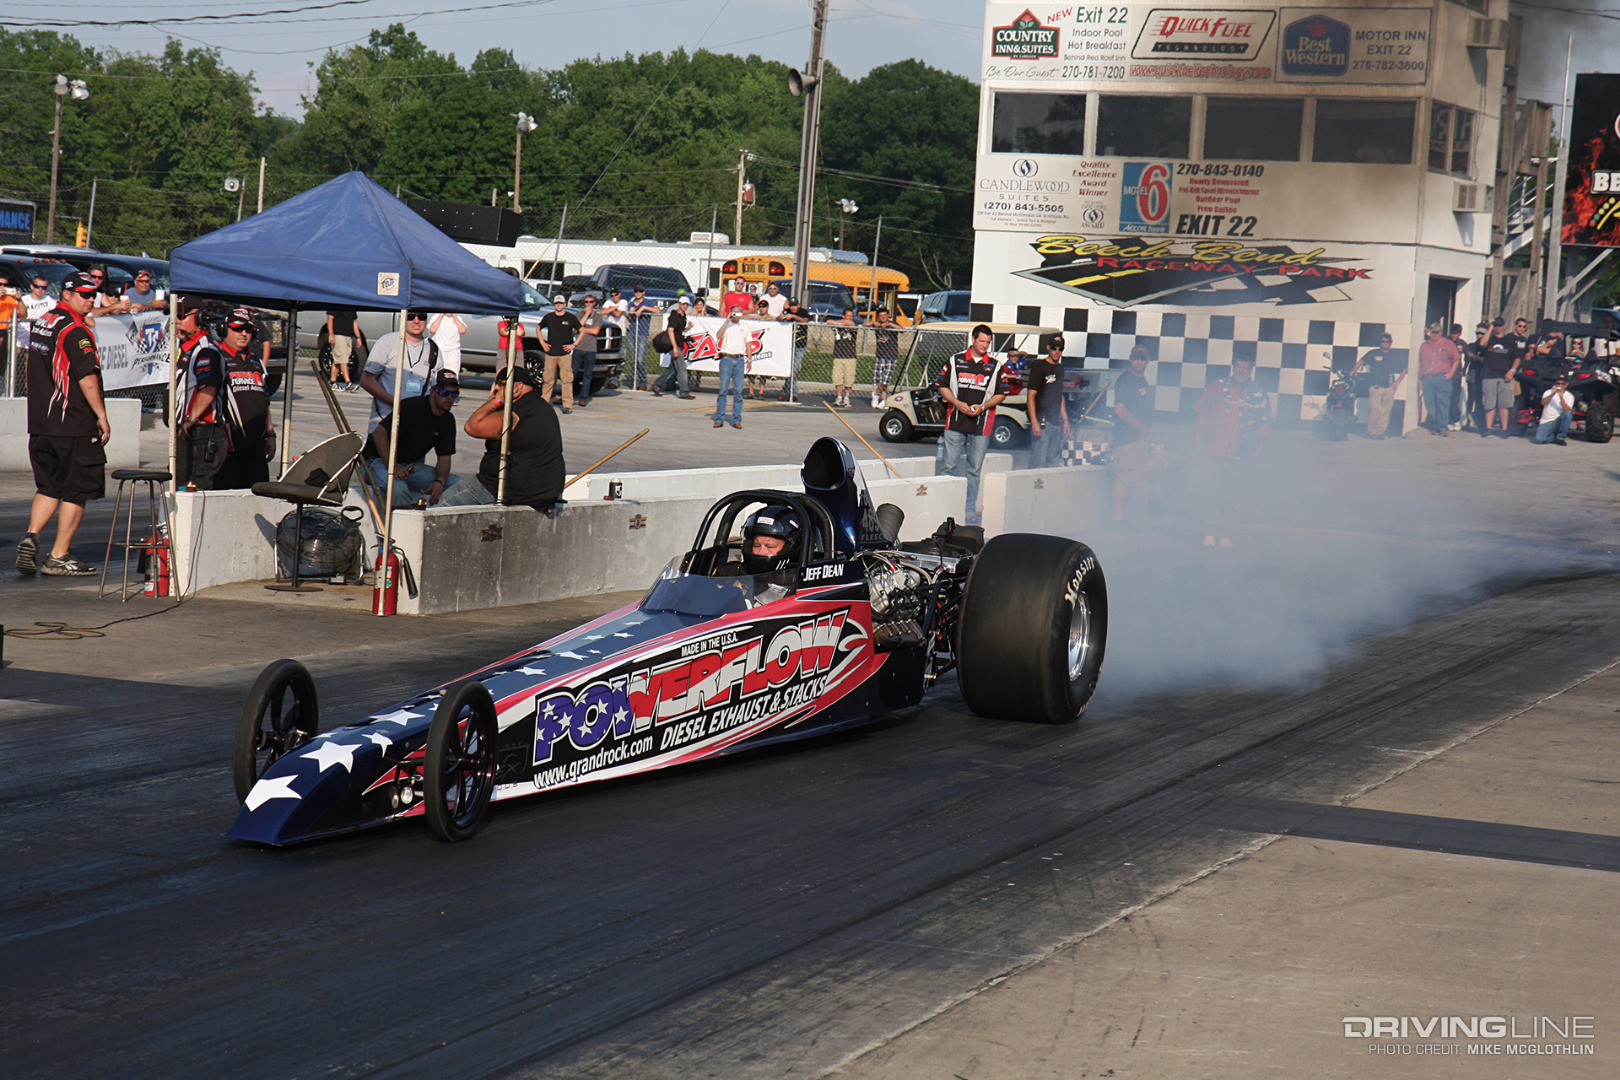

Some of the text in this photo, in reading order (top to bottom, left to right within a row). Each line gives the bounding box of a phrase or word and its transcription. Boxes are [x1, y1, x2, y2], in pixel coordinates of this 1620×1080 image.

[1047, 7, 1073, 24] NEW
[1076, 7, 1128, 23] Exit 22
[996, 30, 1055, 42] COUNTRY
[1072, 29, 1123, 37] Indoor Pool
[1355, 31, 1426, 41] MOTOR INN
[1068, 41, 1126, 49] Hot Breakfast
[1299, 36, 1332, 51] Best
[1367, 45, 1412, 56] EXIT 22
[1286, 50, 1345, 65] Western
[986, 65, 1001, 77] Be
[1062, 65, 1125, 79] 270-781-7200
[1352, 60, 1424, 71] 270-782-3800
[1080, 160, 1111, 169] Quality
[1176, 163, 1264, 177] 270-843-0140
[1072, 170, 1117, 178] Excellence
[980, 179, 1070, 192] CANDLEWOOD
[1079, 189, 1108, 197] Winner
[1123, 163, 1170, 223] MOTEL 6
[984, 202, 1064, 212] (270) 843-5505
[1176, 214, 1258, 236] EXIT 22
[1036, 235, 1326, 265] Beech Bend
[1097, 257, 1374, 279] RACEWAY PARK
[107, 344, 128, 370] DIESEL
[803, 564, 845, 581] JEFF DEAN
[681, 632, 739, 657] MADE IN THE U.S.A.
[533, 608, 848, 766] POWERFLOW
[660, 676, 826, 750] DIESEL EXHAUST & STACKS
[533, 735, 654, 789] www.grandrock.com
